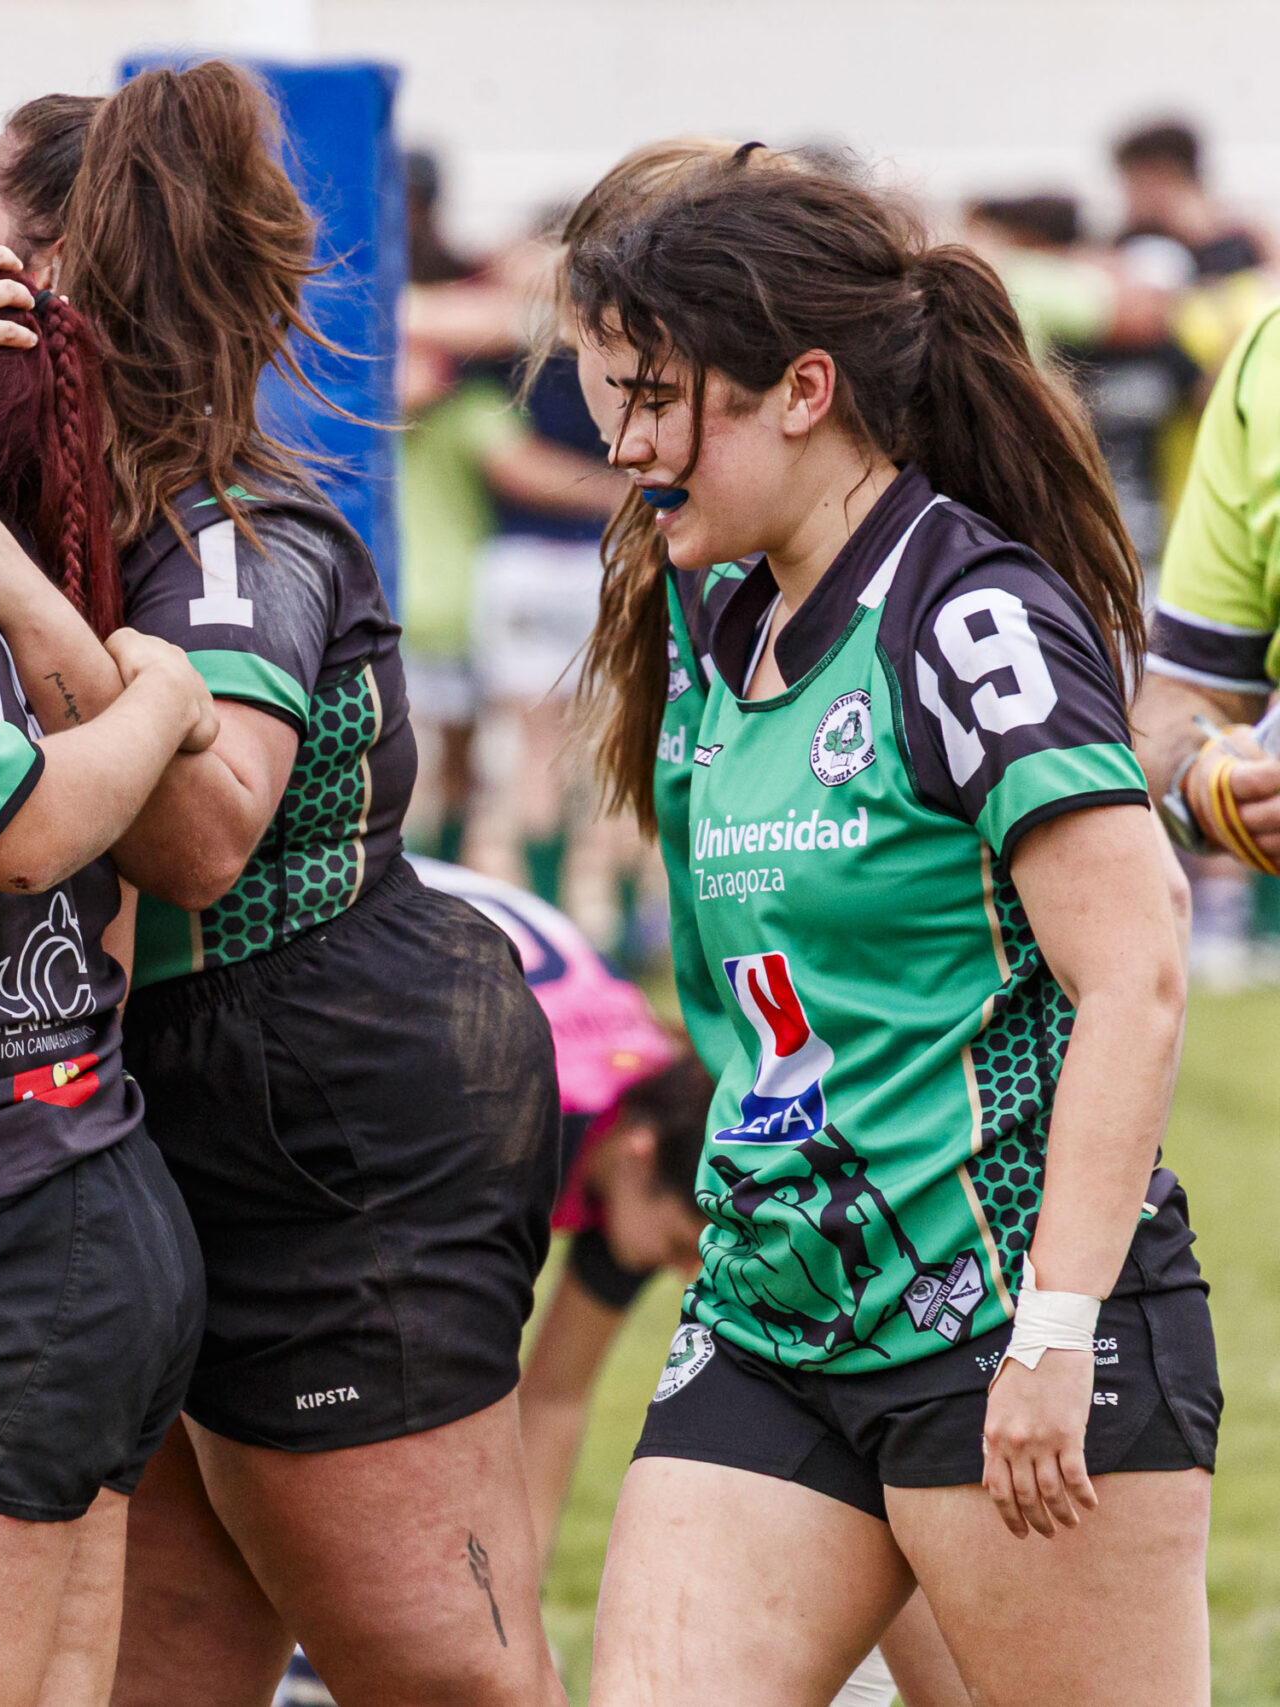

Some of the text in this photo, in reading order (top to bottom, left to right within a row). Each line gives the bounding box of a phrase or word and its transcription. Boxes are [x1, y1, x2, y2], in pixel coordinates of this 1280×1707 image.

[189, 519, 254, 628] 1
[915, 587, 1058, 788] 19
[695, 807, 868, 861] Universidad
[695, 867, 785, 903] Zaragoza
[27, 1035, 60, 1055] CANINA
[923, 1256, 968, 1327] PRODUCTO OFICIAL
[295, 1386, 360, 1410] KIPSTA
